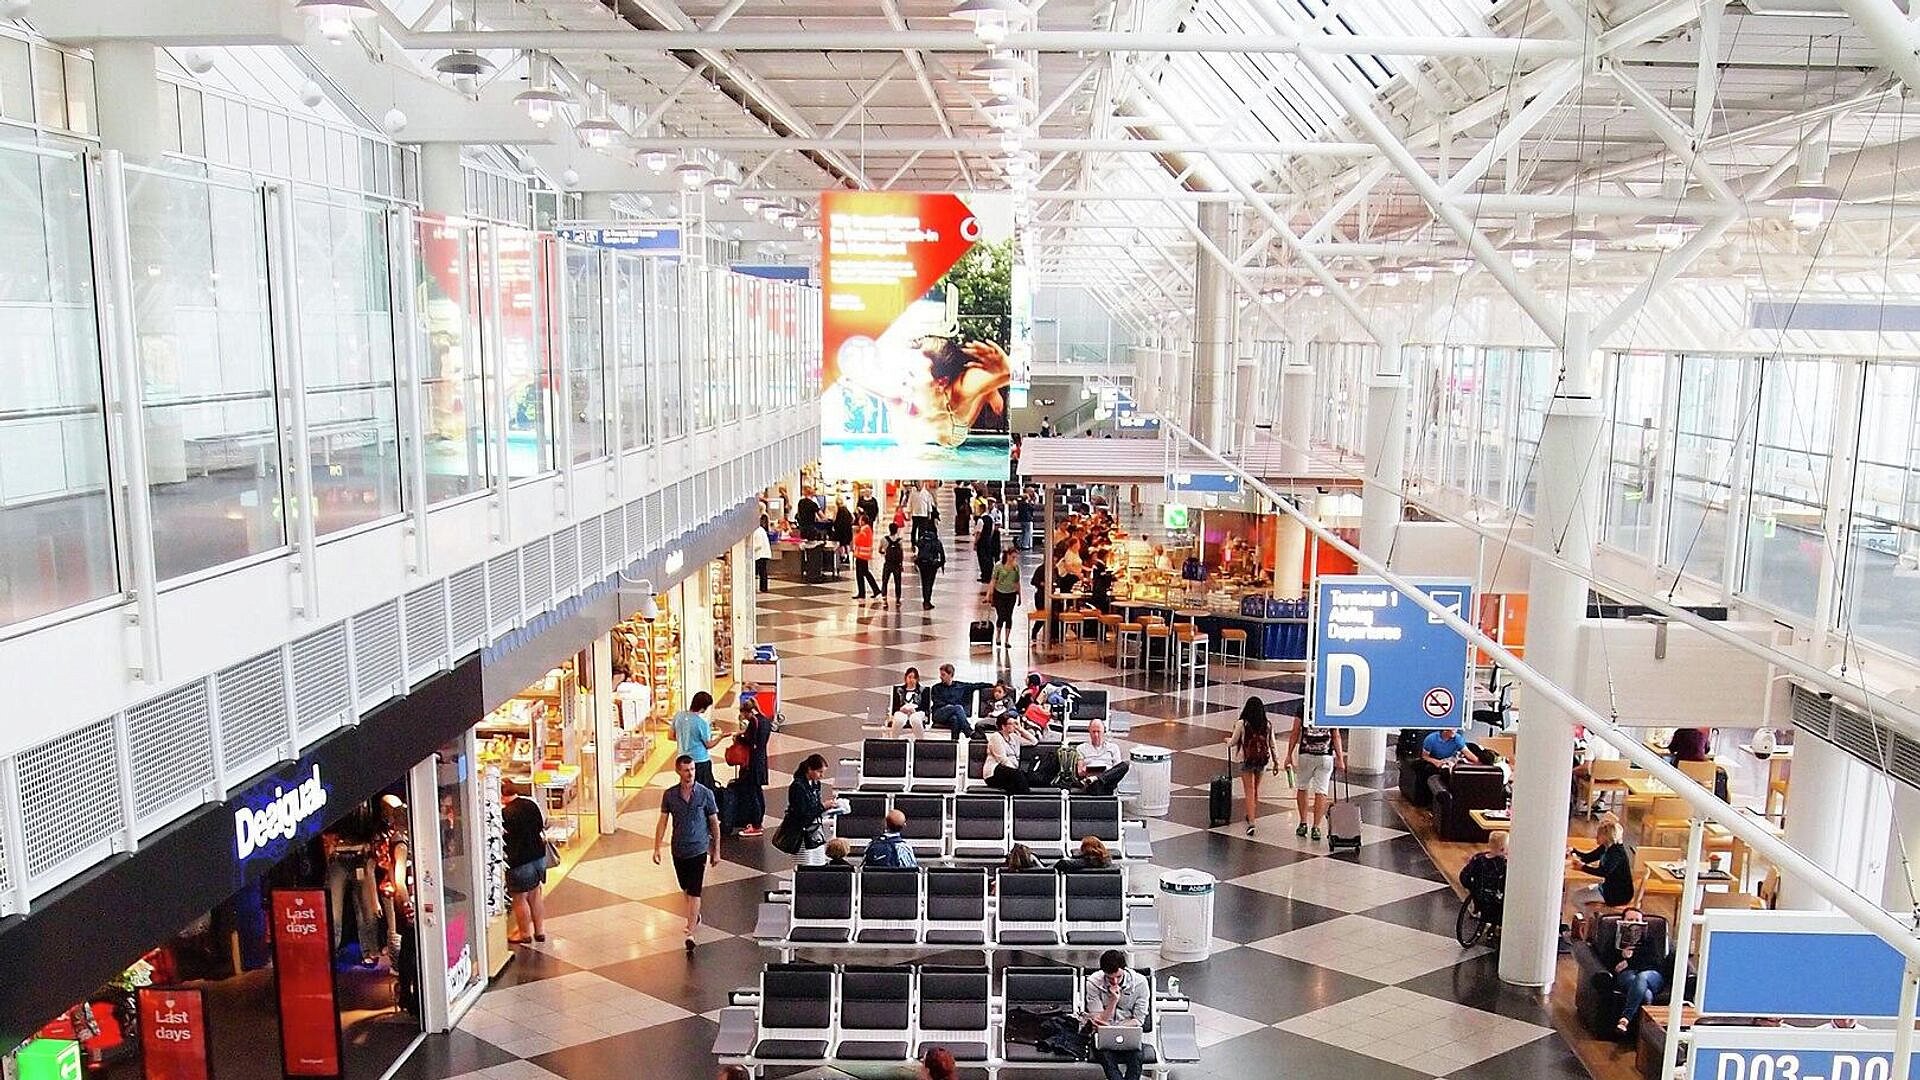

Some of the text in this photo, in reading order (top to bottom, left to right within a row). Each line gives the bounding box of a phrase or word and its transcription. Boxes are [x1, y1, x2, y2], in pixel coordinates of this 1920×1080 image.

[1330, 590, 1398, 607] Terminal 1
[1327, 623, 1402, 642] Departures
[1325, 653, 1371, 717] D
[286, 907, 316, 919] Last
[286, 921, 318, 936] days
[155, 1010, 190, 1024] Last
[155, 1026, 192, 1043] days
